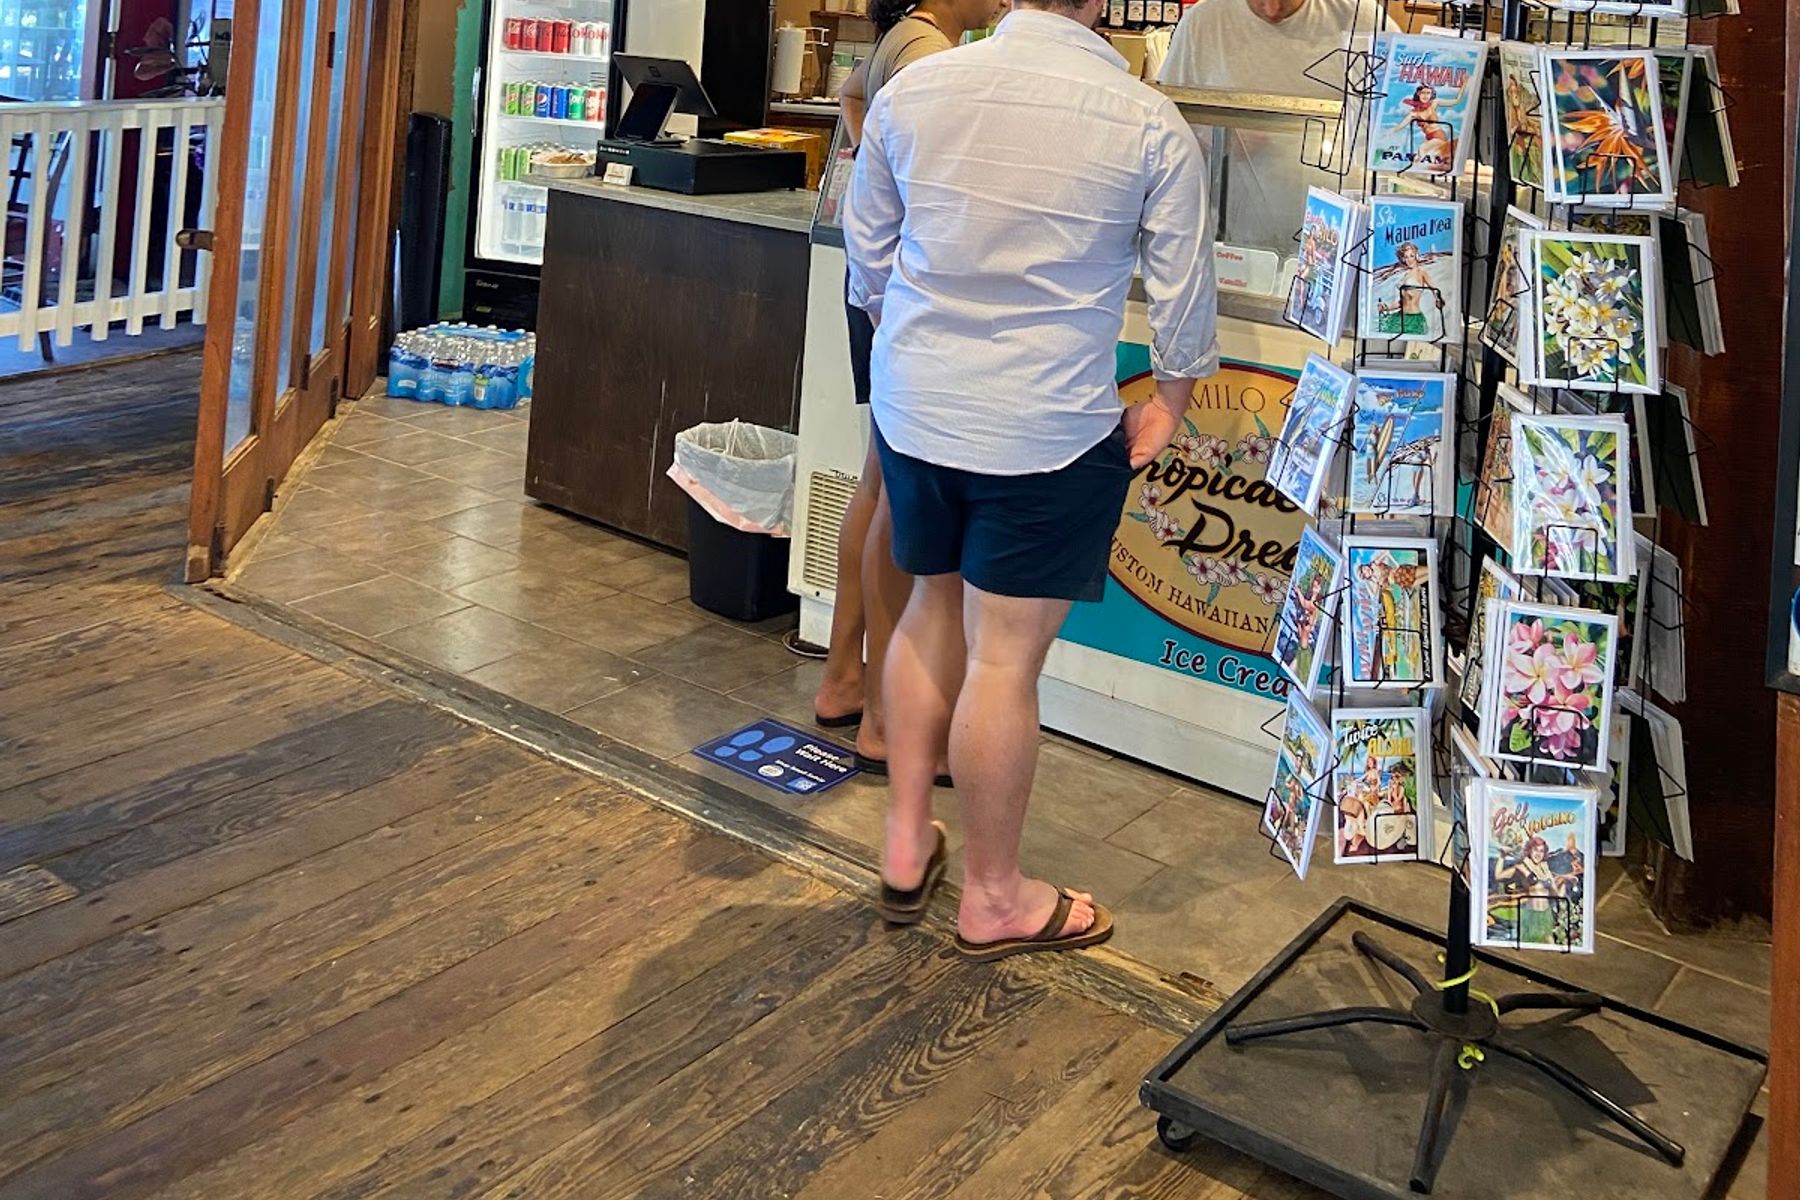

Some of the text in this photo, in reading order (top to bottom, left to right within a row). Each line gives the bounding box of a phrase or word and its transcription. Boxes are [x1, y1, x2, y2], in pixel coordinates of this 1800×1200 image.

[1385, 222, 1427, 247] Mauna
[1190, 383, 1267, 414] MILO
[1132, 452, 1298, 513] ropica
[1162, 498, 1298, 573] Drea
[1167, 586, 1269, 635] HAWAIIAN
[1159, 639, 1296, 699] Ice Crea
